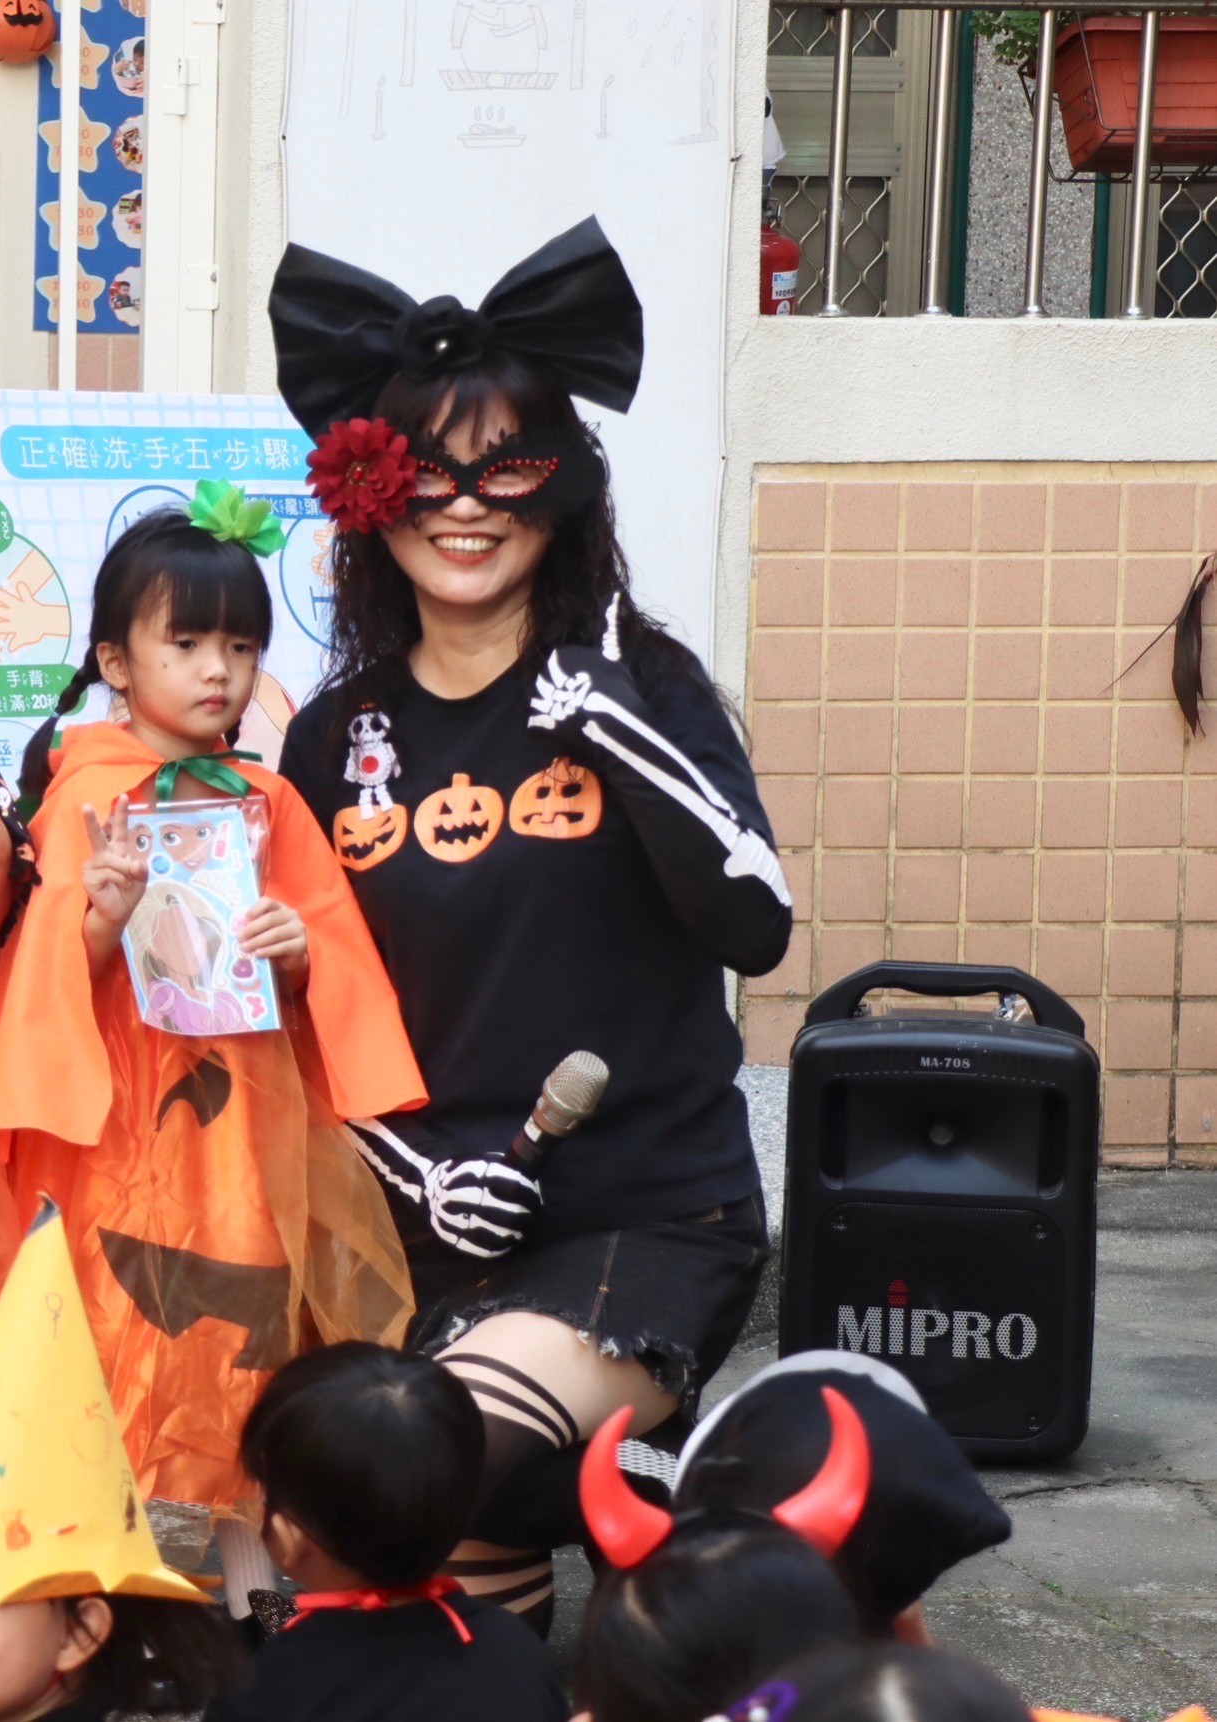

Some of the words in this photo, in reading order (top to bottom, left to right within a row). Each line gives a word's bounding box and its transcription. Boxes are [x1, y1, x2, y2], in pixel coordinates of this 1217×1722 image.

[17, 435, 298, 471] 正確洗手五步驟
[919, 1056, 971, 1069] MA-708
